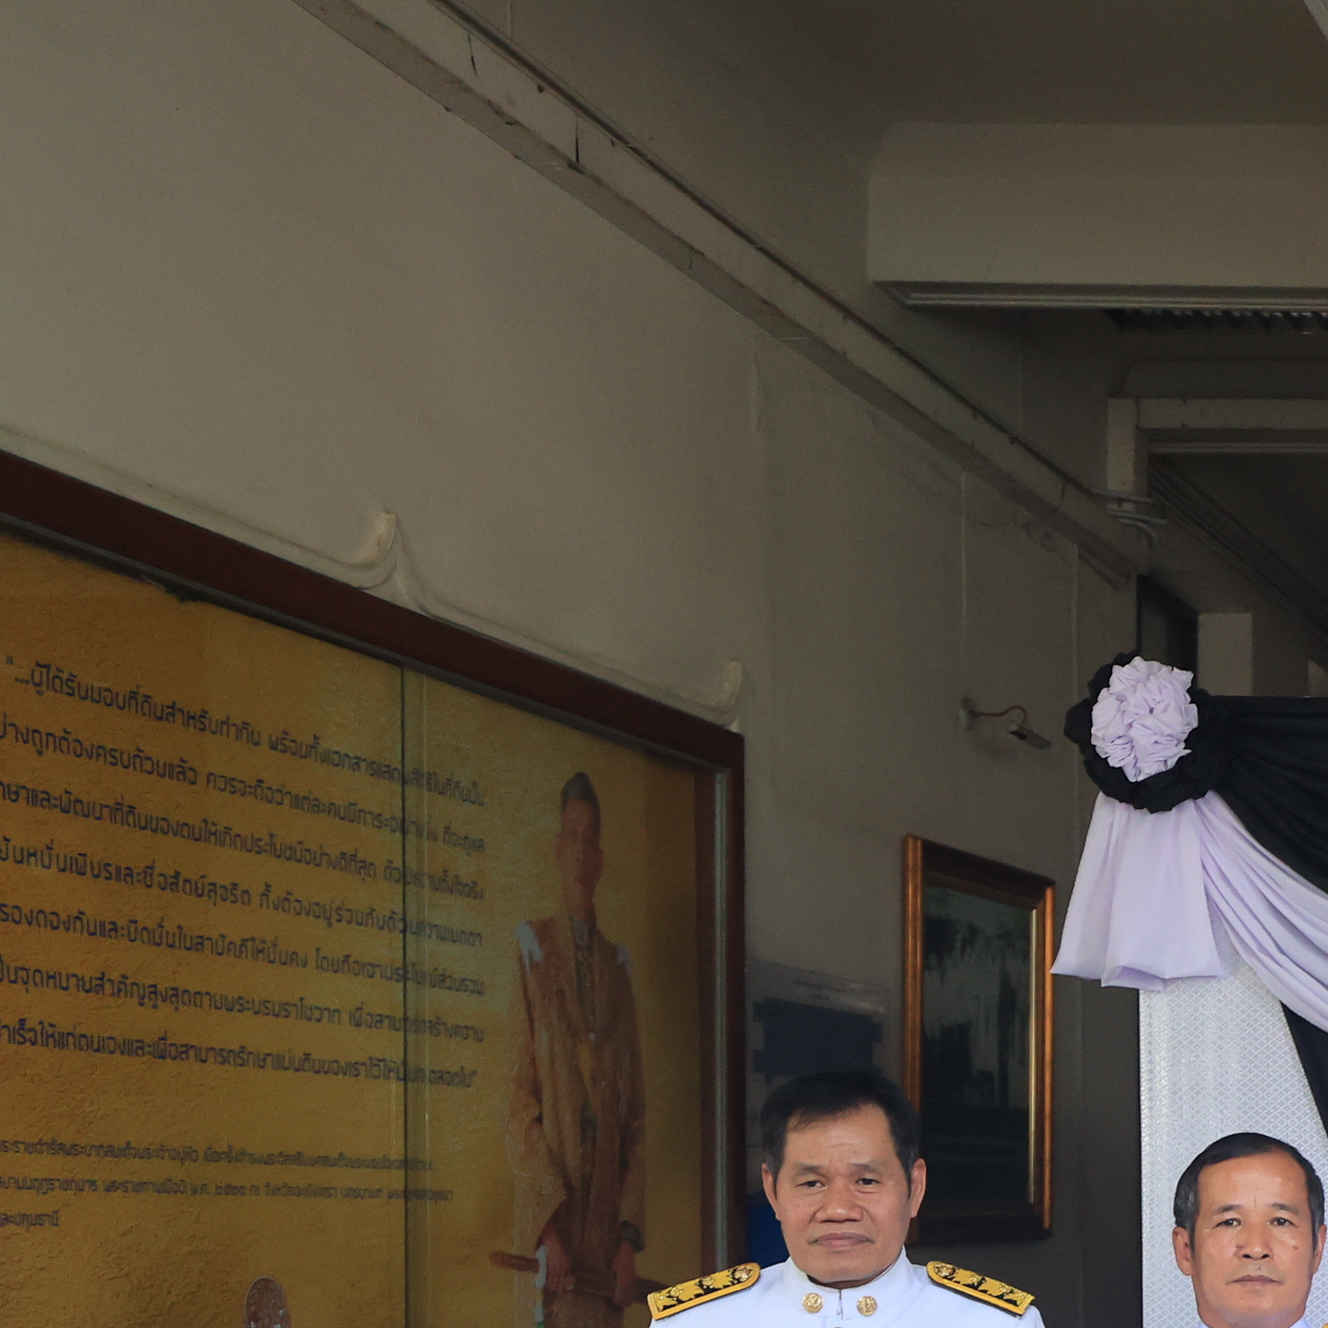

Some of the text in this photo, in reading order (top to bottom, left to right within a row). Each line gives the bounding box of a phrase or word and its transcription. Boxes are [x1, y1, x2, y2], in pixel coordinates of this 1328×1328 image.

[348, 1000, 485, 1043] เพื่อสามรถสร้างความ
